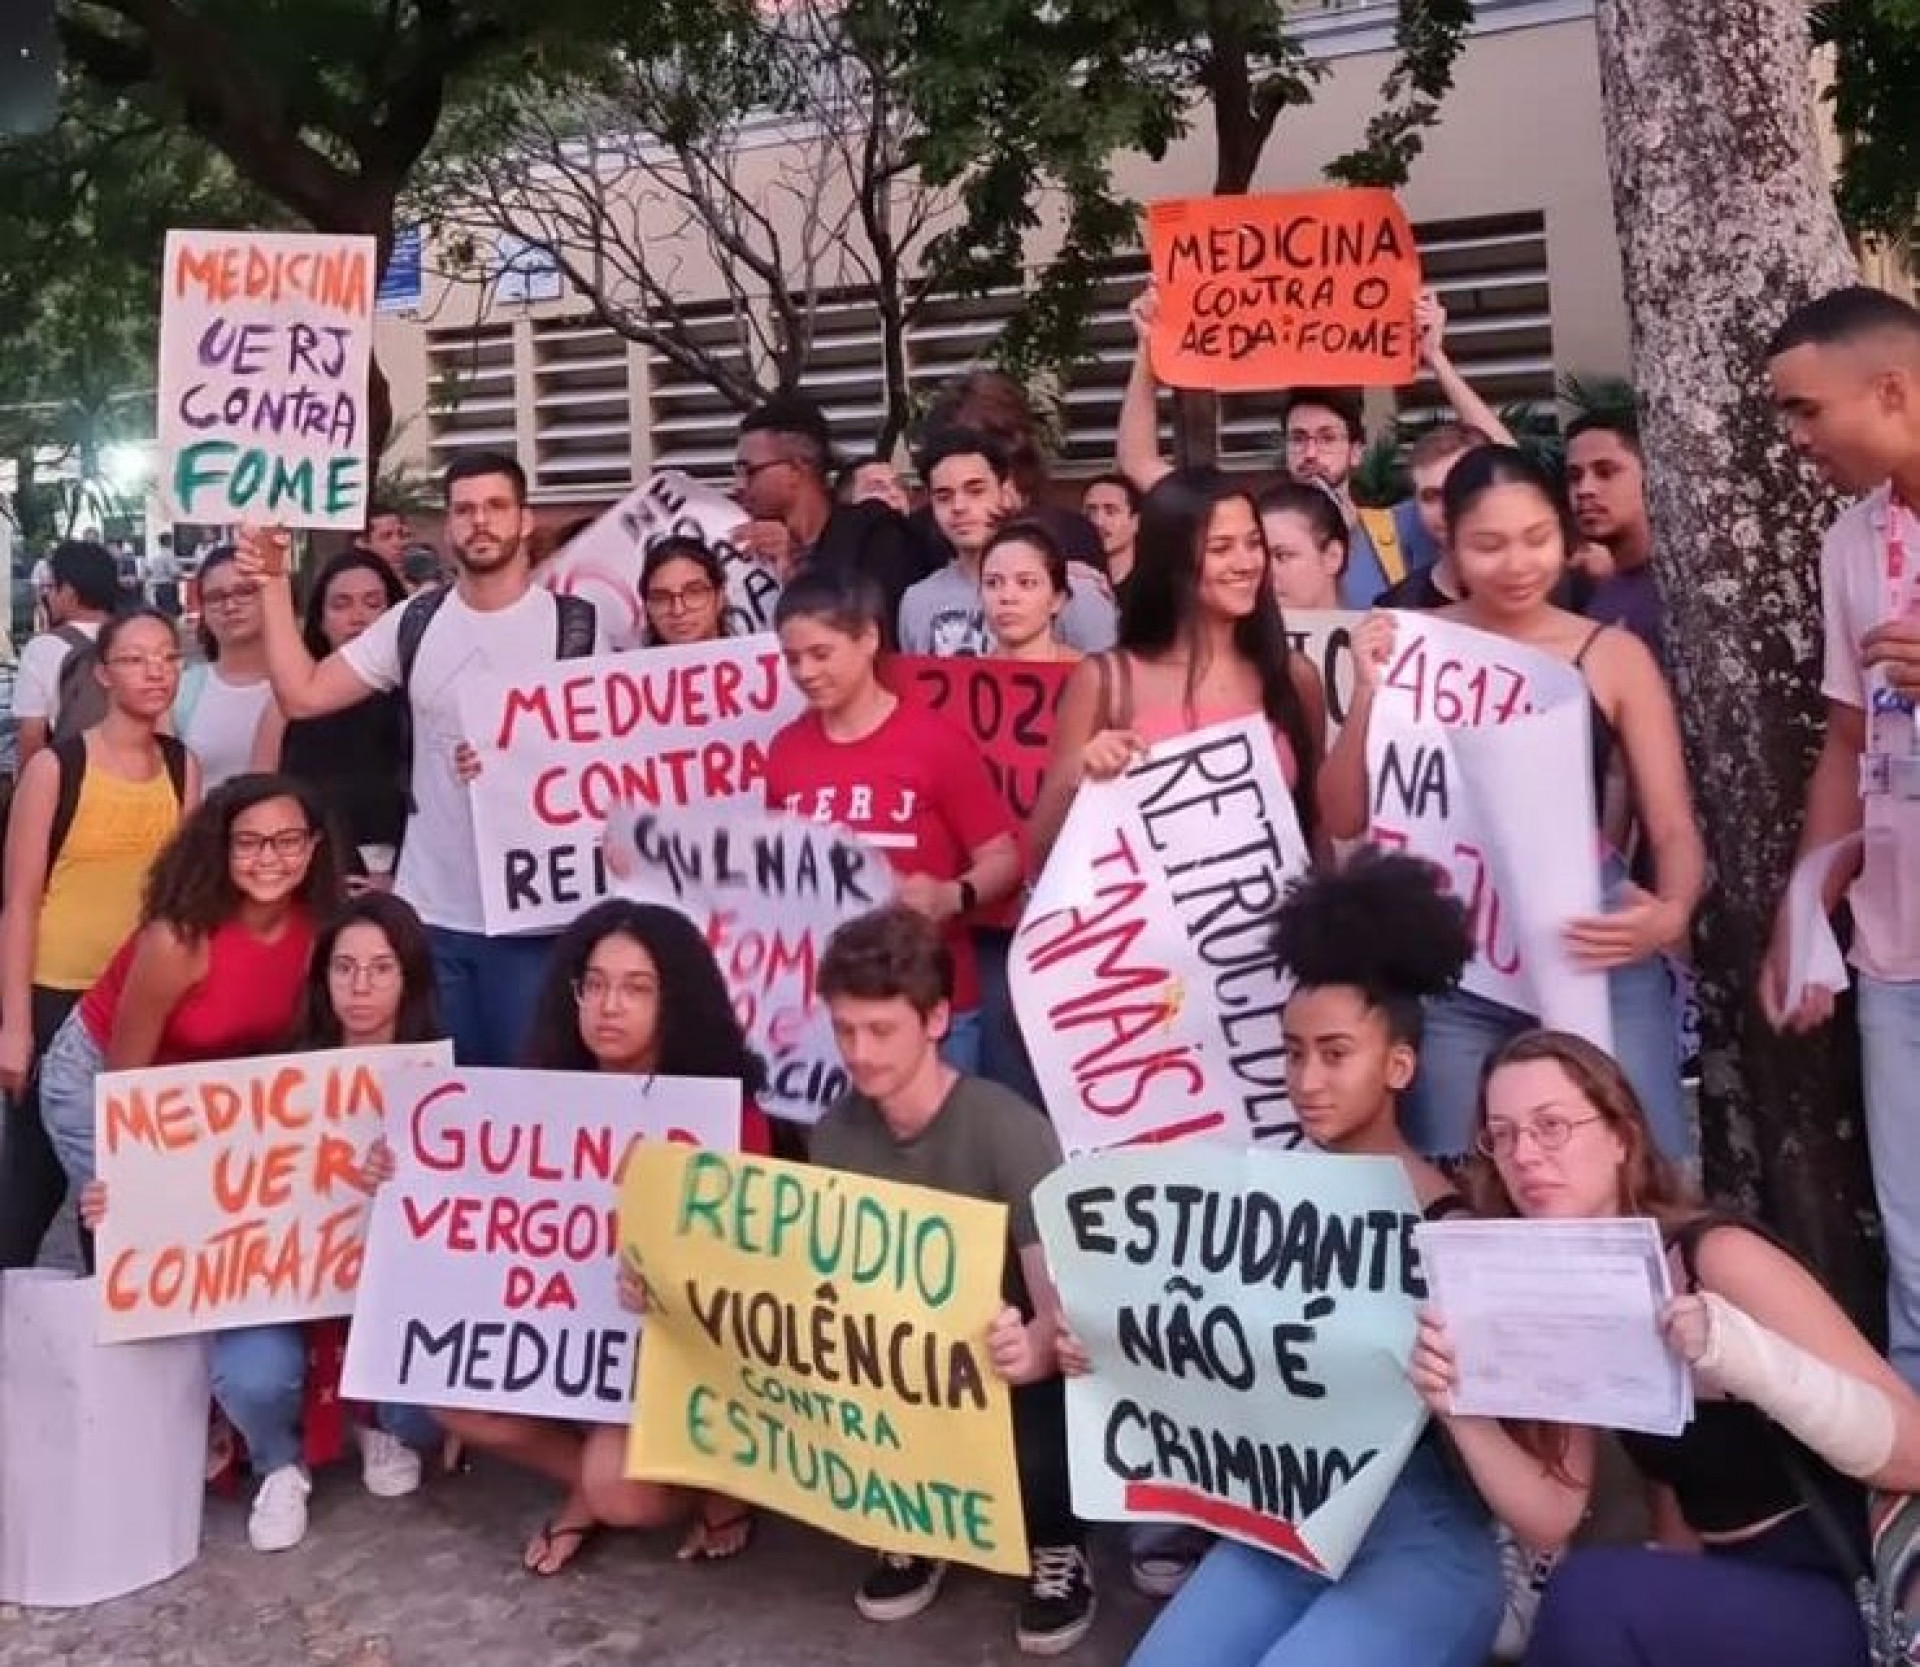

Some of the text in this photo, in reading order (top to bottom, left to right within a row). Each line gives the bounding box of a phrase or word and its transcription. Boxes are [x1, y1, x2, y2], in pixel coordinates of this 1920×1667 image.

[175, 245, 369, 317] MEDICINA
[1168, 216, 1404, 284] MEDICINA
[1193, 274, 1389, 318] CONTRA O
[179, 380, 356, 449] CONTRA
[173, 441, 362, 516] FOME
[533, 740, 771, 826] CONTRA
[1374, 740, 1449, 820] NA
[632, 813, 874, 905] GULNAR
[105, 1219, 302, 1315] CONTRA
[403, 1196, 619, 1261] VERGO
[678, 1152, 957, 1309] REPÚDIO
[1066, 1184, 1429, 1300] ESTUDANTE
[503, 1265, 578, 1311] DA
[397, 1318, 644, 1403] MEDUE
[685, 1281, 989, 1411] VIOLÊNCIA
[1116, 1275, 1256, 1393] NÃO
[1273, 1297, 1336, 1398] É
[739, 1367, 902, 1451] CONTRA
[685, 1384, 996, 1551] ESTUDANTE
